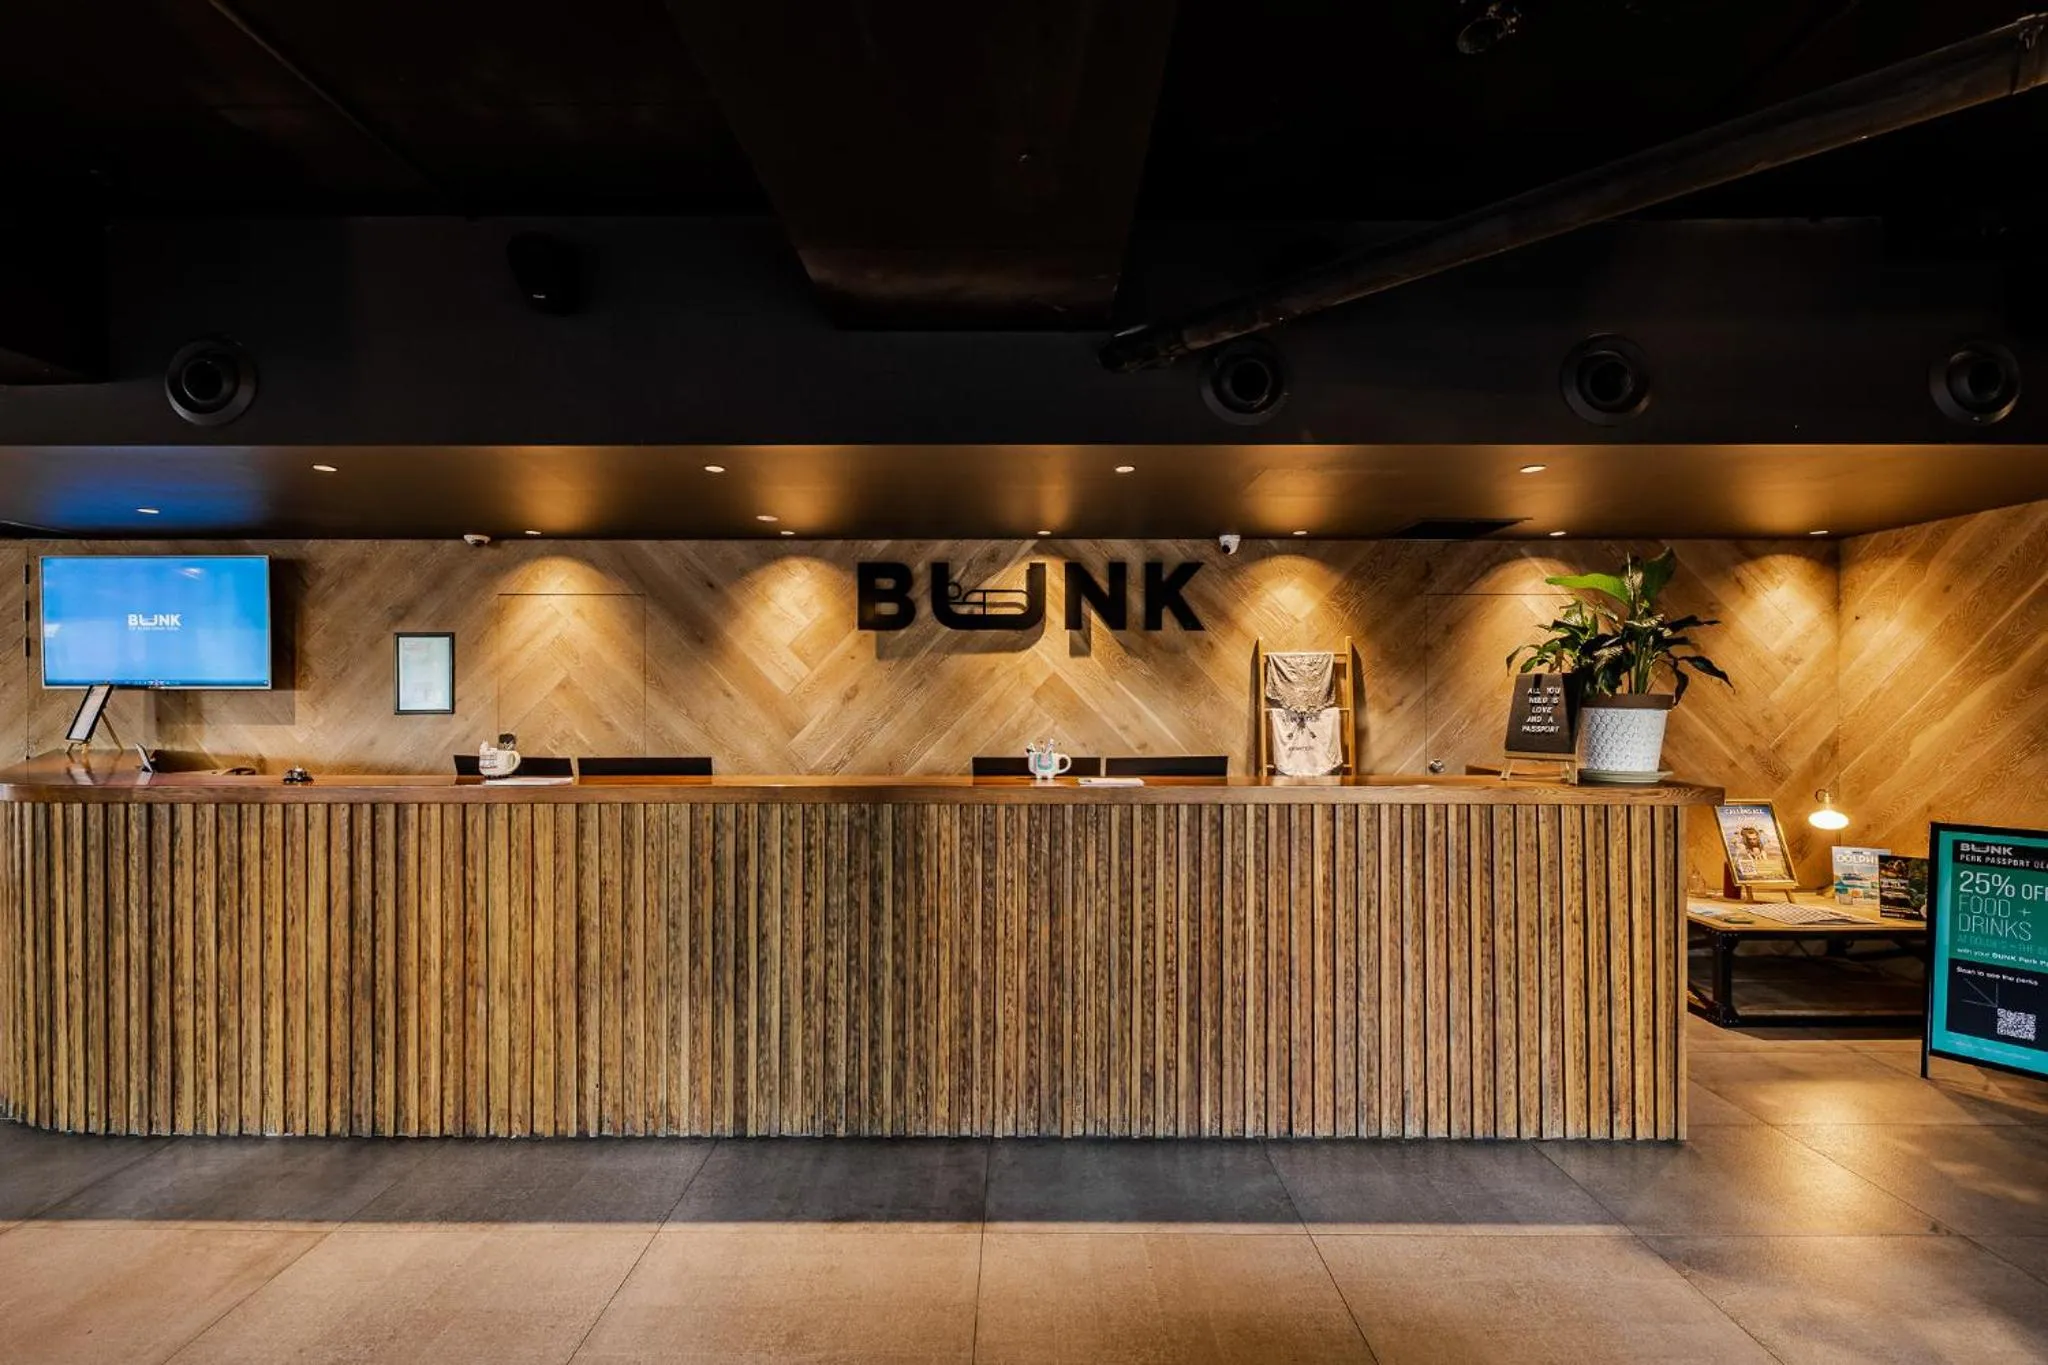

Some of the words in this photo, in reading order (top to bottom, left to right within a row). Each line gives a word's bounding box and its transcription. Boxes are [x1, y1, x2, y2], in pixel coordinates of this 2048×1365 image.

[857, 562, 1205, 631] BUNK
[128, 614, 181, 626] BUNK
[1527, 687, 1541, 695] ALL
[1546, 687, 1560, 695] YOU
[1528, 696, 1548, 704] NEED
[1531, 706, 1553, 714] LOVE
[1526, 715, 1542, 723] AND
[1547, 715, 1554, 723] A
[1521, 725, 1560, 733] PASSPORT
[1960, 842, 2014, 856] BUNK
[1960, 854, 1982, 863] PERK
[1985, 856, 2031, 868] PASSPORT
[1960, 870, 2016, 898] 25%
[1959, 893, 2011, 918] FOOD
[1959, 913, 2032, 942] DRINKS
